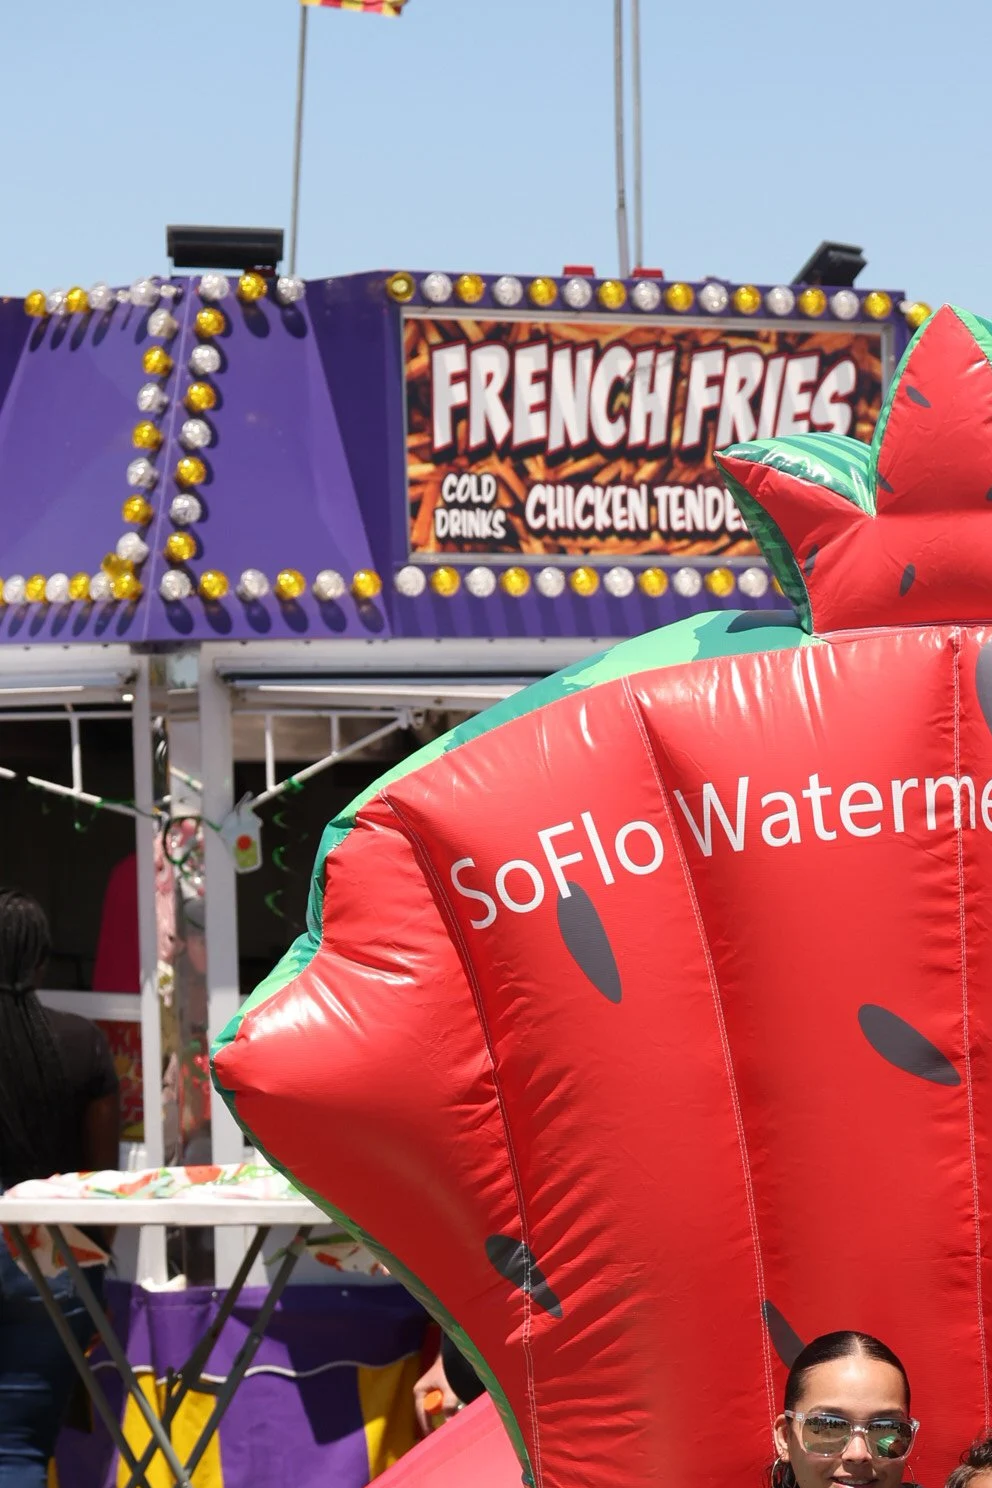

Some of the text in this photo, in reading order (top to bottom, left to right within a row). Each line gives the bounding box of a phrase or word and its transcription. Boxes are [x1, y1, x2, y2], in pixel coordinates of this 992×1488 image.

[430, 342, 858, 454] FRENCH FRIES
[441, 472, 497, 504] COLD
[524, 483, 749, 533] CHICKEN TENDE
[434, 507, 507, 540] DRINKS
[449, 811, 665, 931] SoFlo
